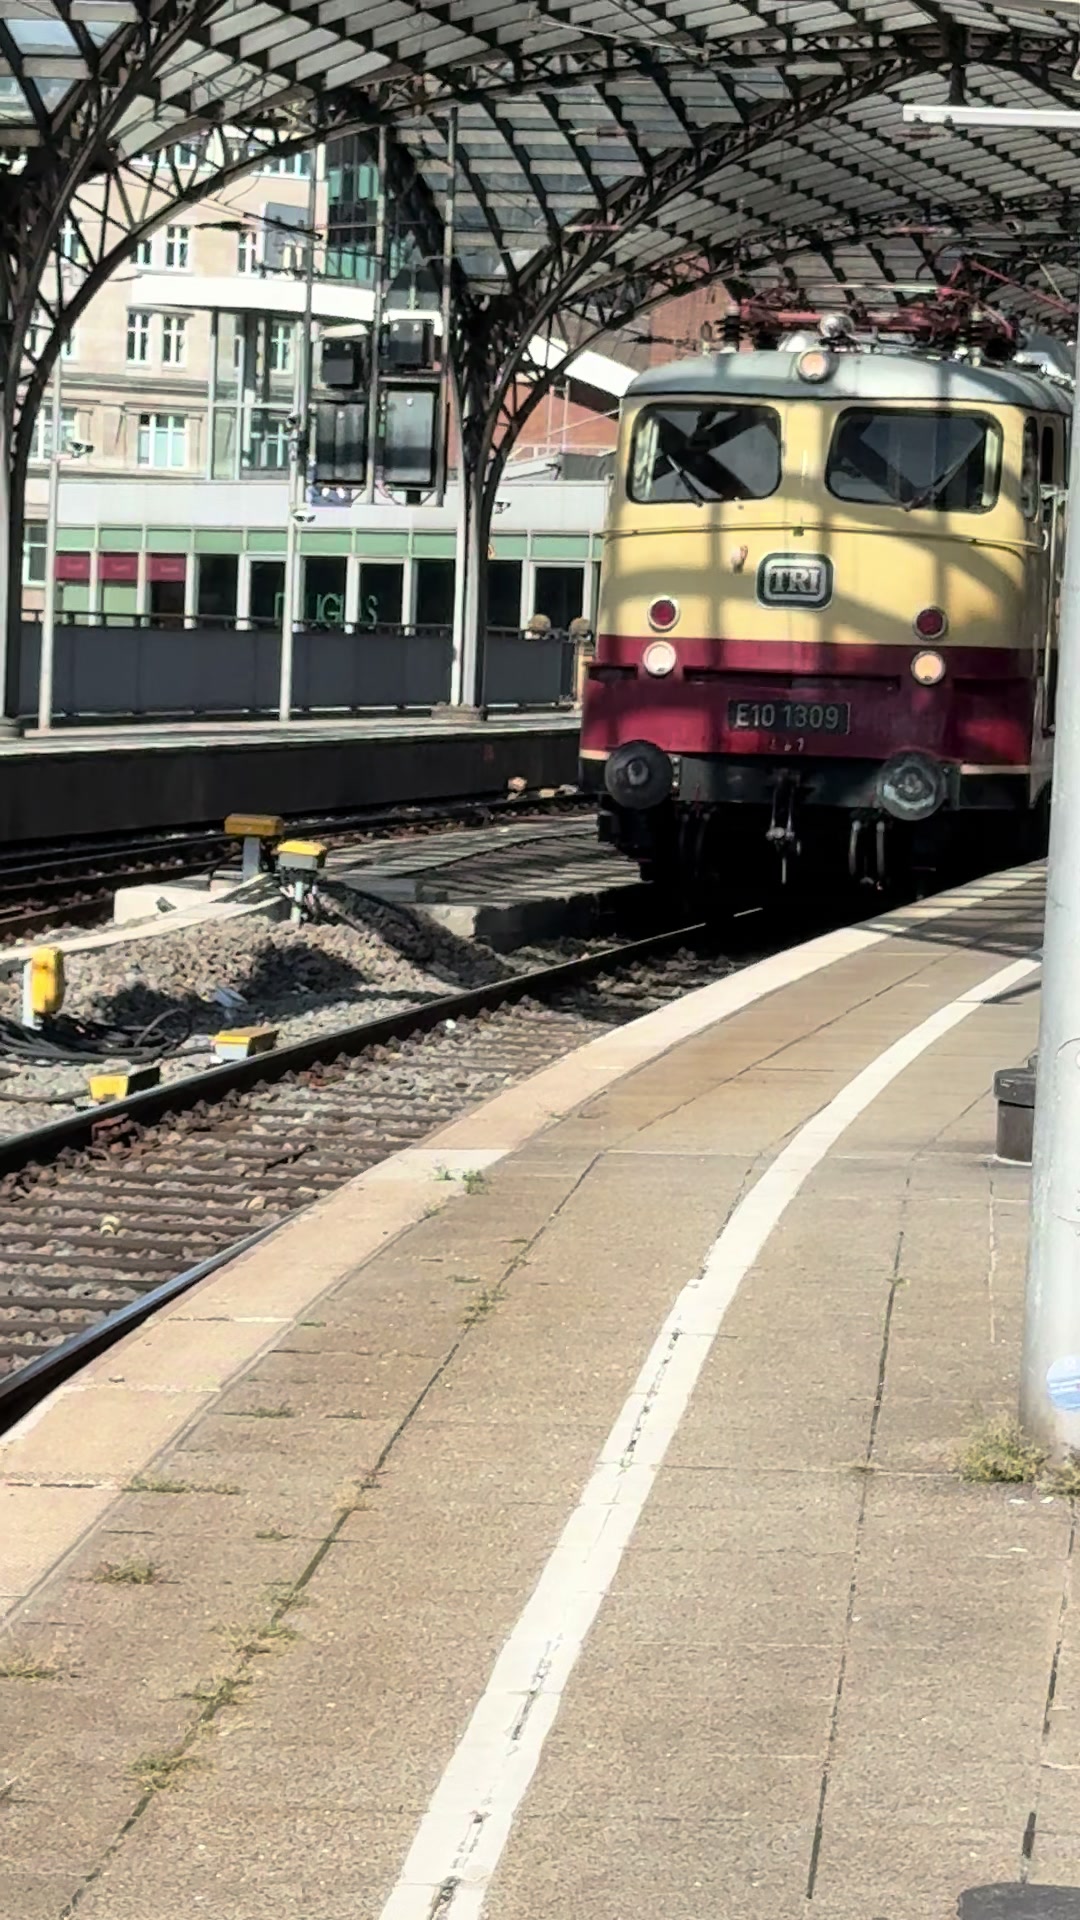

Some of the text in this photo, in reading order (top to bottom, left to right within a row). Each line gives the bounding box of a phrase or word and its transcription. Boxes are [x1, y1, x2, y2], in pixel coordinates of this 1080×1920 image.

[770, 567, 820, 593] TRI
[735, 703, 839, 730] E10 1309
